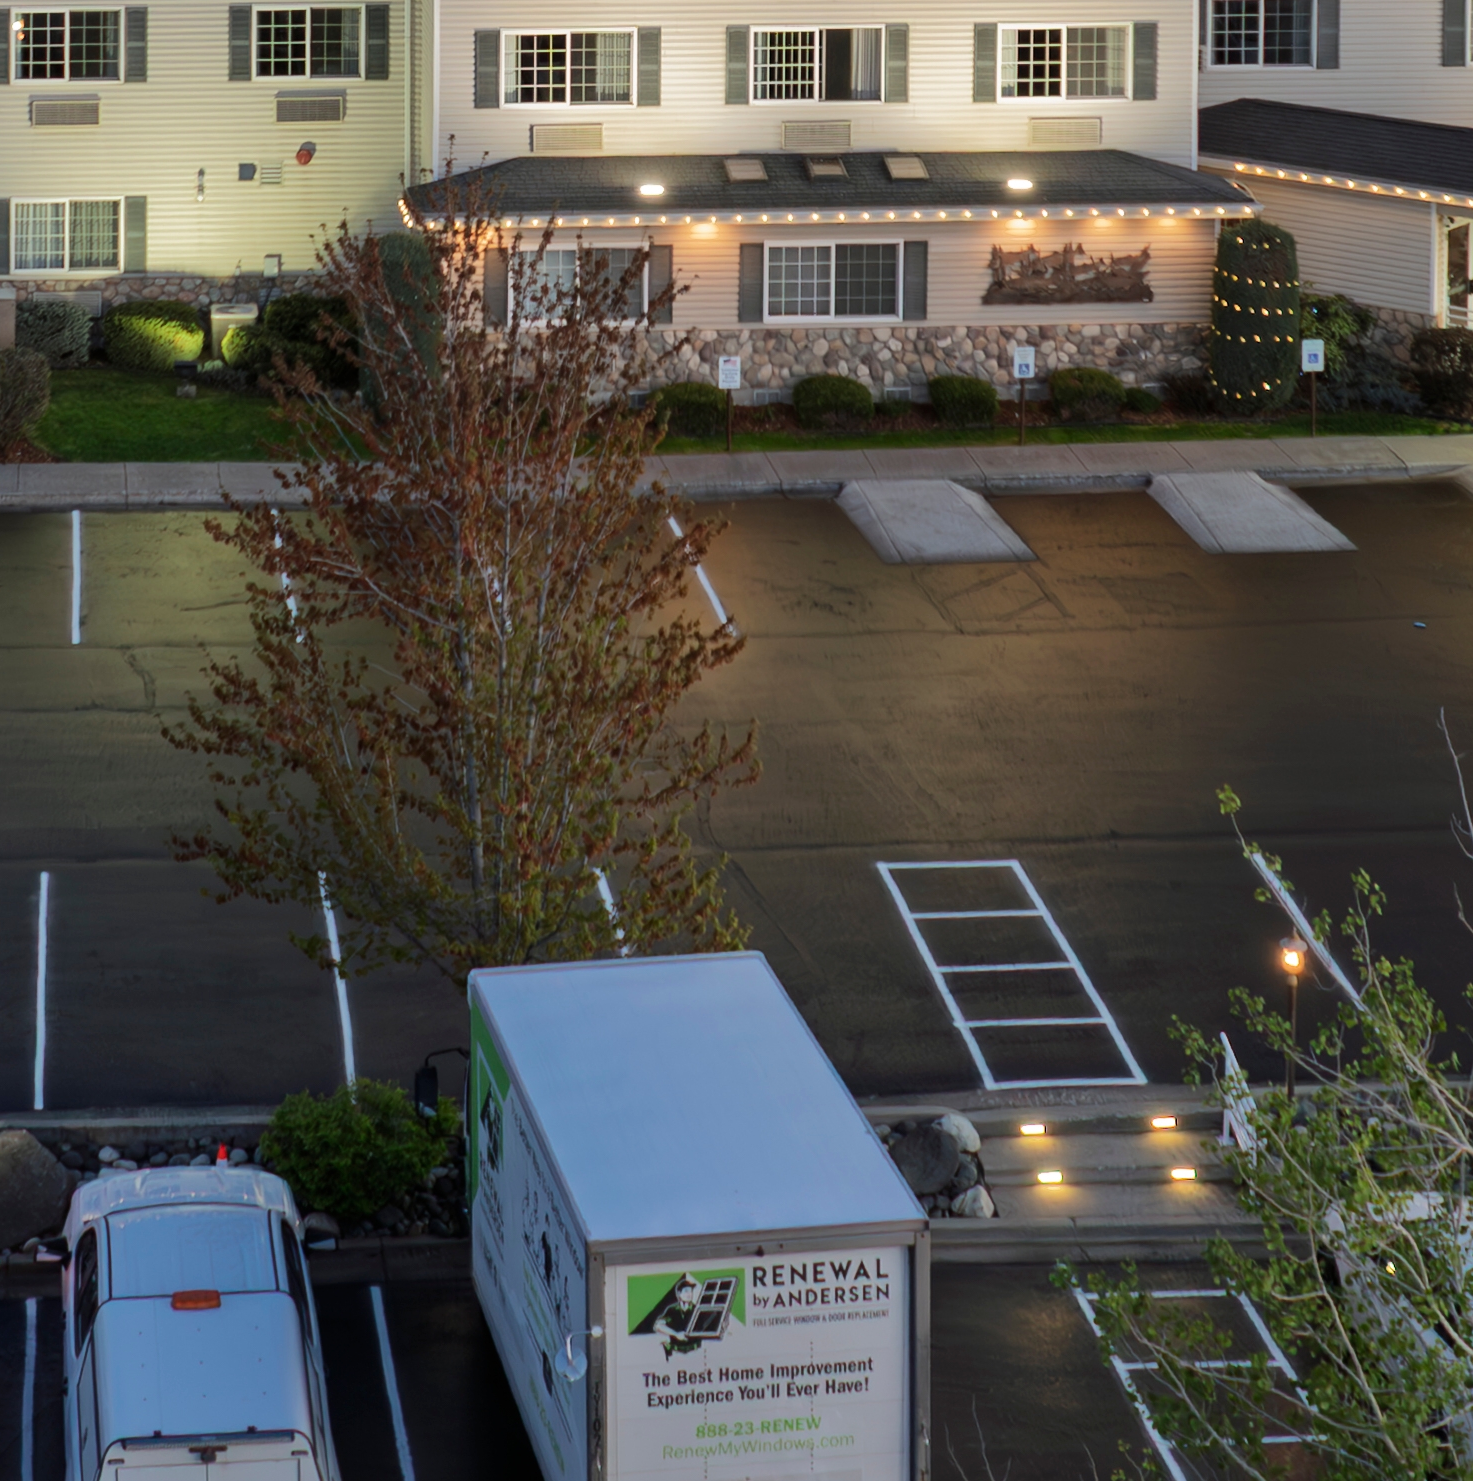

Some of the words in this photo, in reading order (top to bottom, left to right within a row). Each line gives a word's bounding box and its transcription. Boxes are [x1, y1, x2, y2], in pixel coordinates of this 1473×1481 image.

[752, 1258, 889, 1288] RENEWAL
[753, 1293, 770, 1309] by
[773, 1283, 890, 1308] ANDERSEN
[768, 1315, 792, 1327] SERVICE
[793, 1313, 820, 1325] WINDOW
[847, 1308, 890, 1320] REPLACEMENT
[643, 1372, 671, 1388] The
[677, 1368, 713, 1385] Best
[719, 1366, 764, 1382] Home
[770, 1357, 874, 1381] Improvement
[647, 1389, 733, 1409] Experience
[738, 1382, 780, 1401] You'll
[787, 1381, 820, 1397] Ever
[825, 1377, 870, 1396] Have!
[696, 1416, 822, 1439] 888-23-RENEW
[662, 1433, 855, 1460] RenewMyWindows.com
